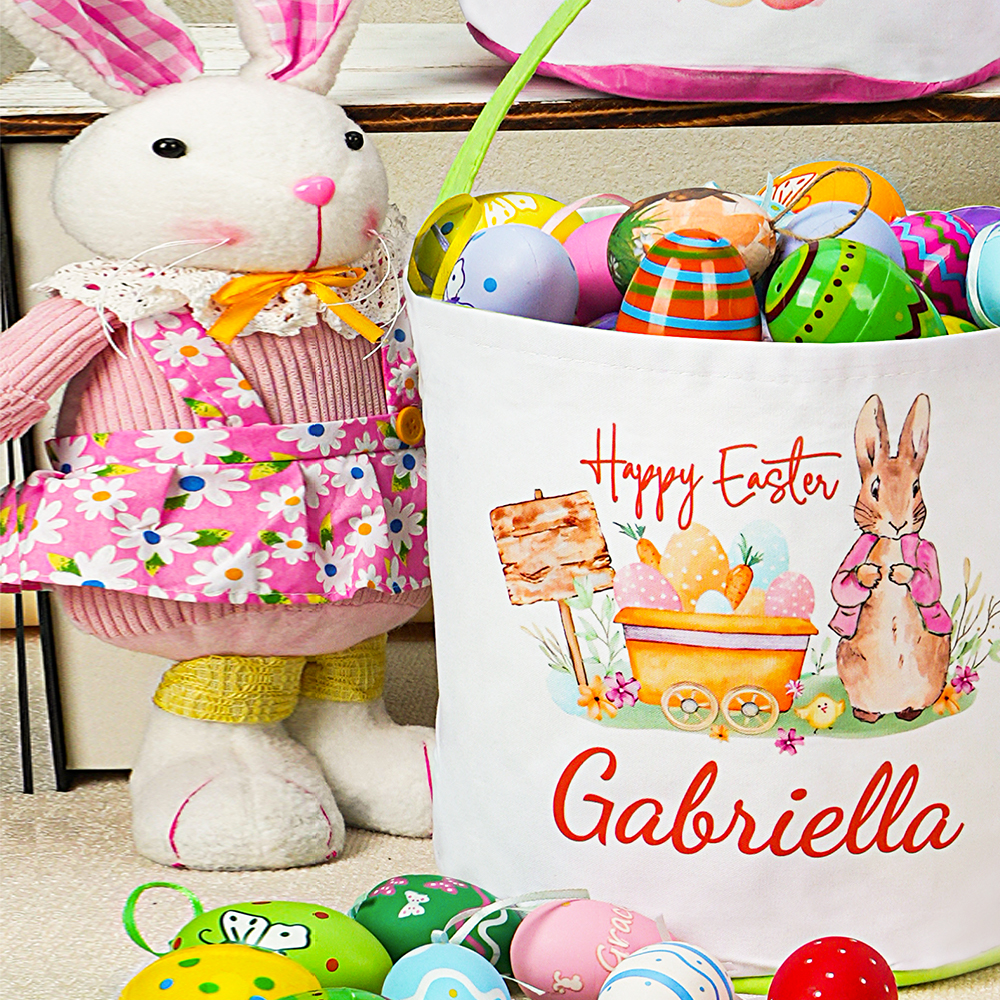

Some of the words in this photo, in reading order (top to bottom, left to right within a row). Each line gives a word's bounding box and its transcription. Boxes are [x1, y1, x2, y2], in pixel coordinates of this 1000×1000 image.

[580, 423, 704, 530] Happy
[712, 436, 842, 508] Easter
[552, 746, 965, 859] Gabriella
